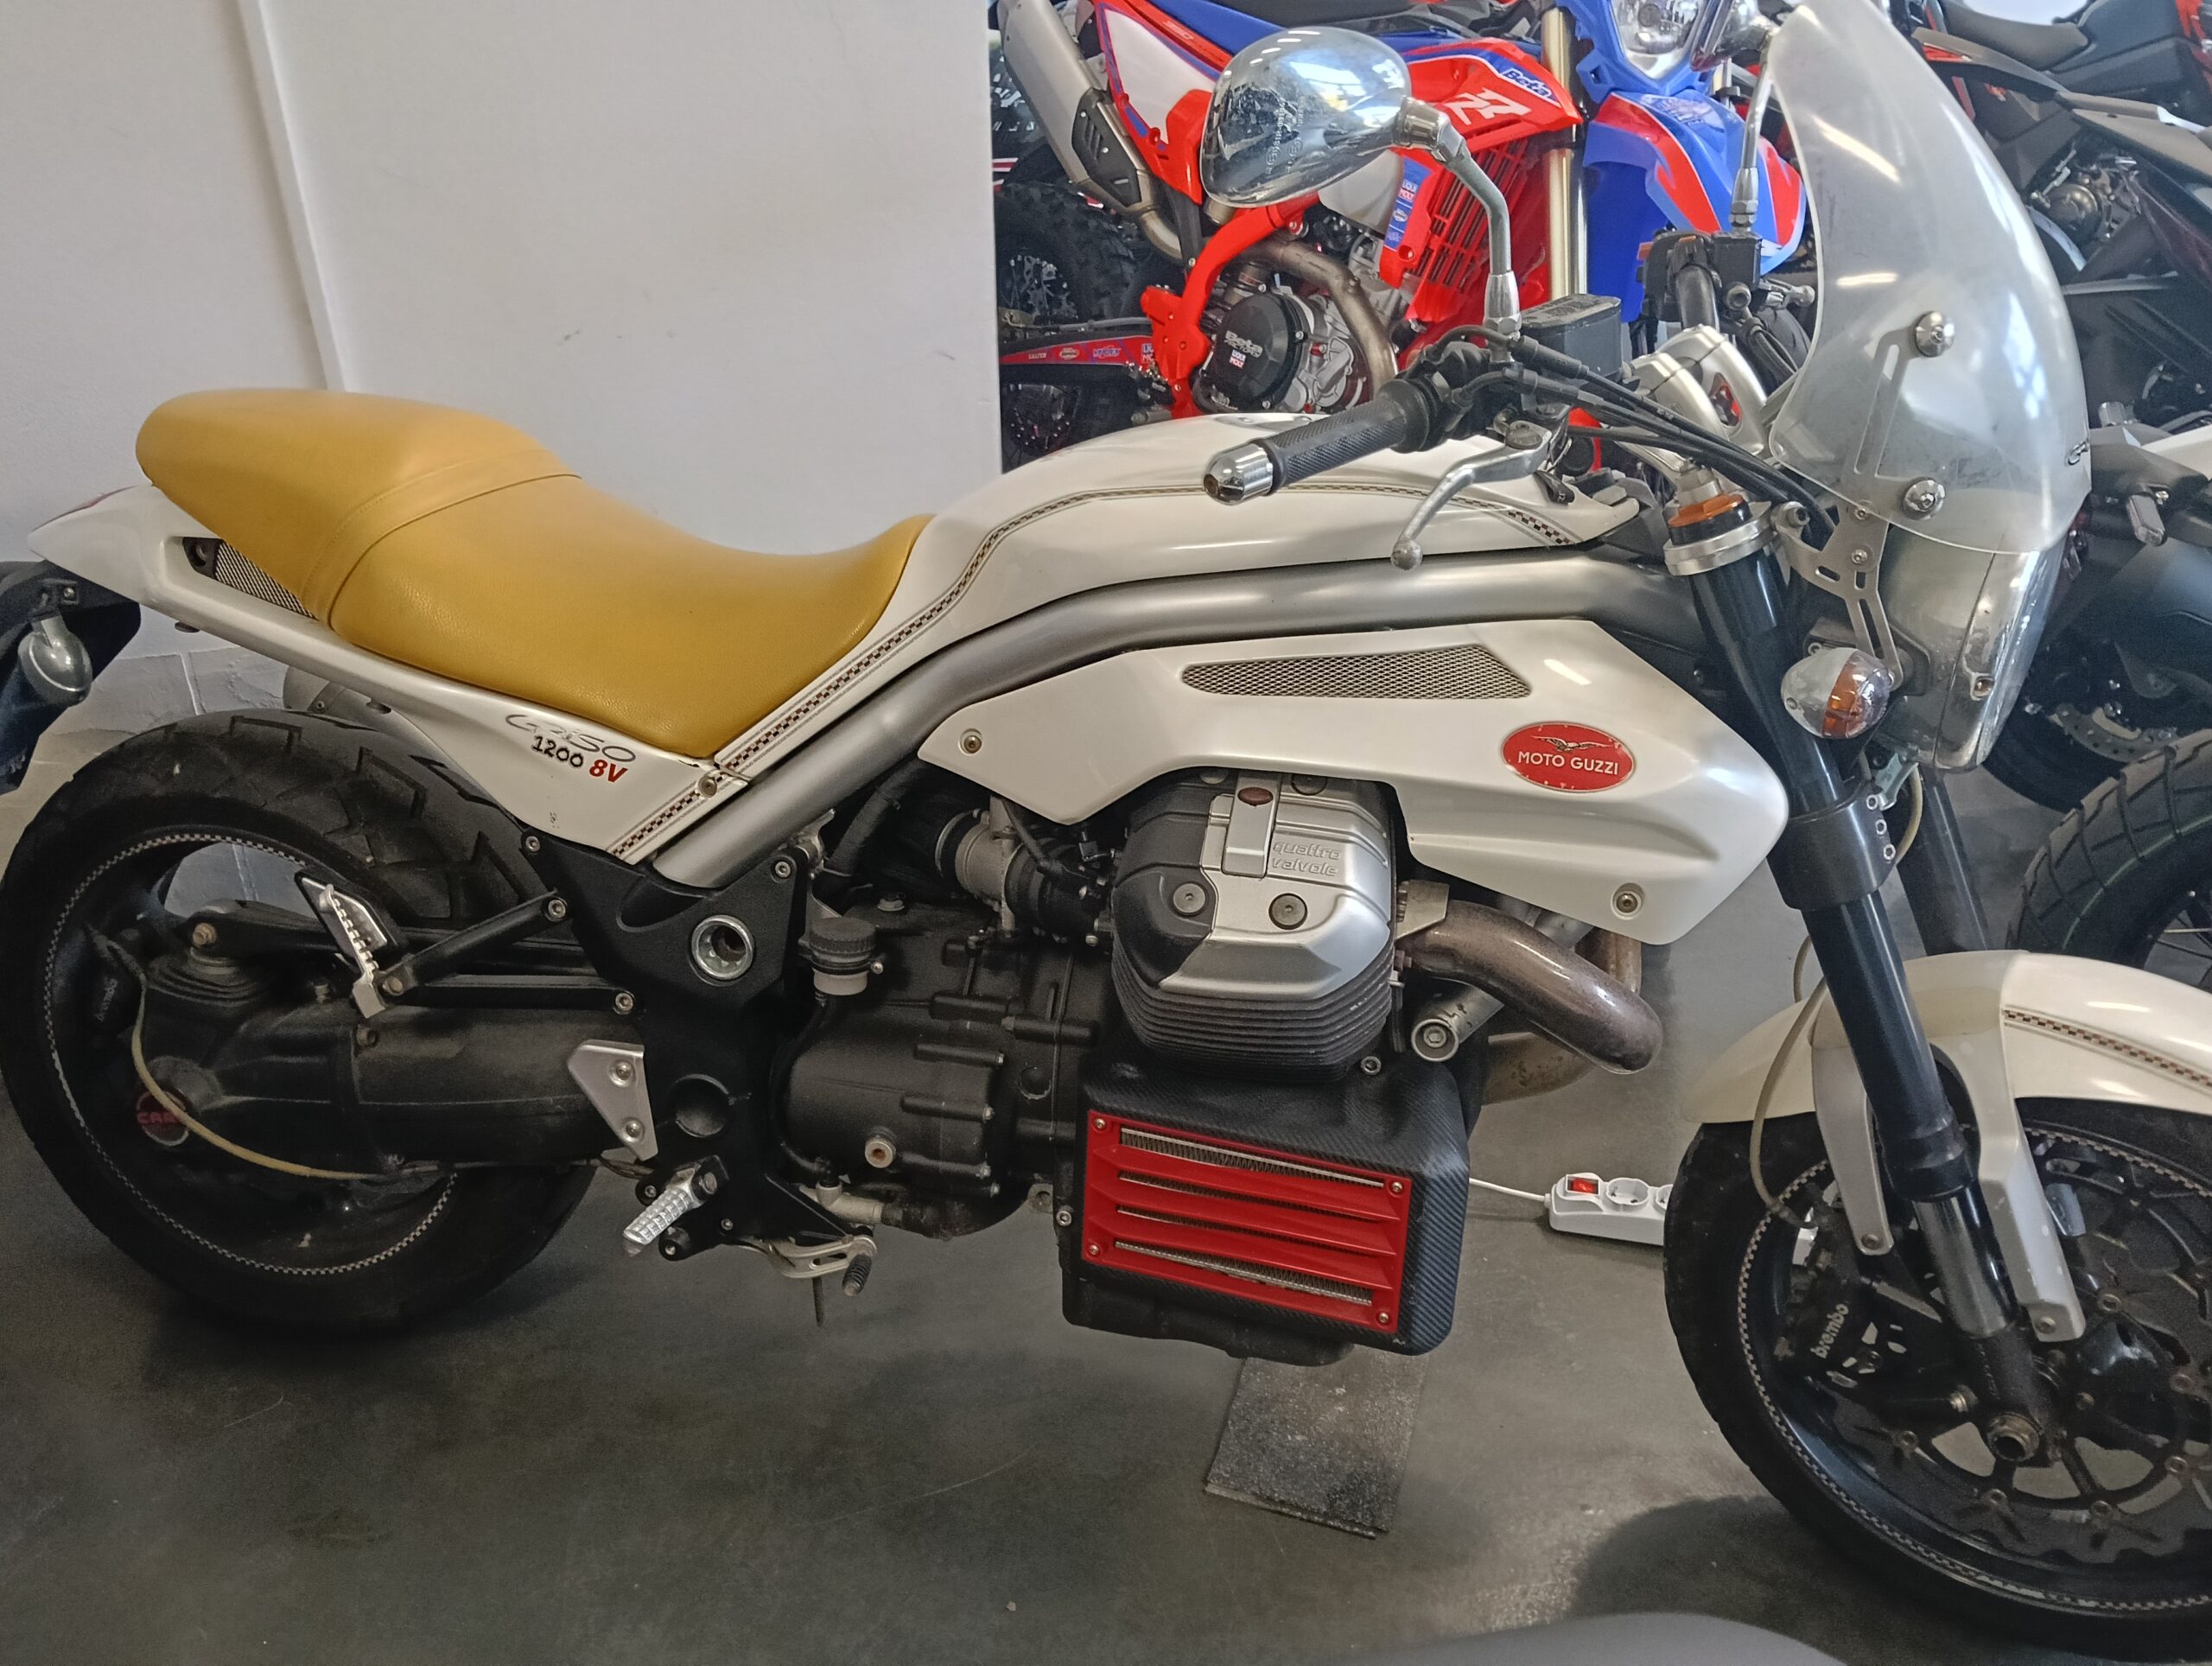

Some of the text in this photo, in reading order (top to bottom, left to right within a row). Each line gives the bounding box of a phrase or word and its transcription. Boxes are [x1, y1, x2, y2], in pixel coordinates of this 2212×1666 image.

[1503, 69, 1551, 98] Beta
[1225, 330, 1262, 353] Beta
[531, 735, 629, 783] 1200 8V
[1517, 751, 1619, 775] MOTO GUZZI
[1273, 841, 1341, 861] quattro
[1271, 857, 1339, 877] valvole
[1809, 1303, 1850, 1359] brembo
